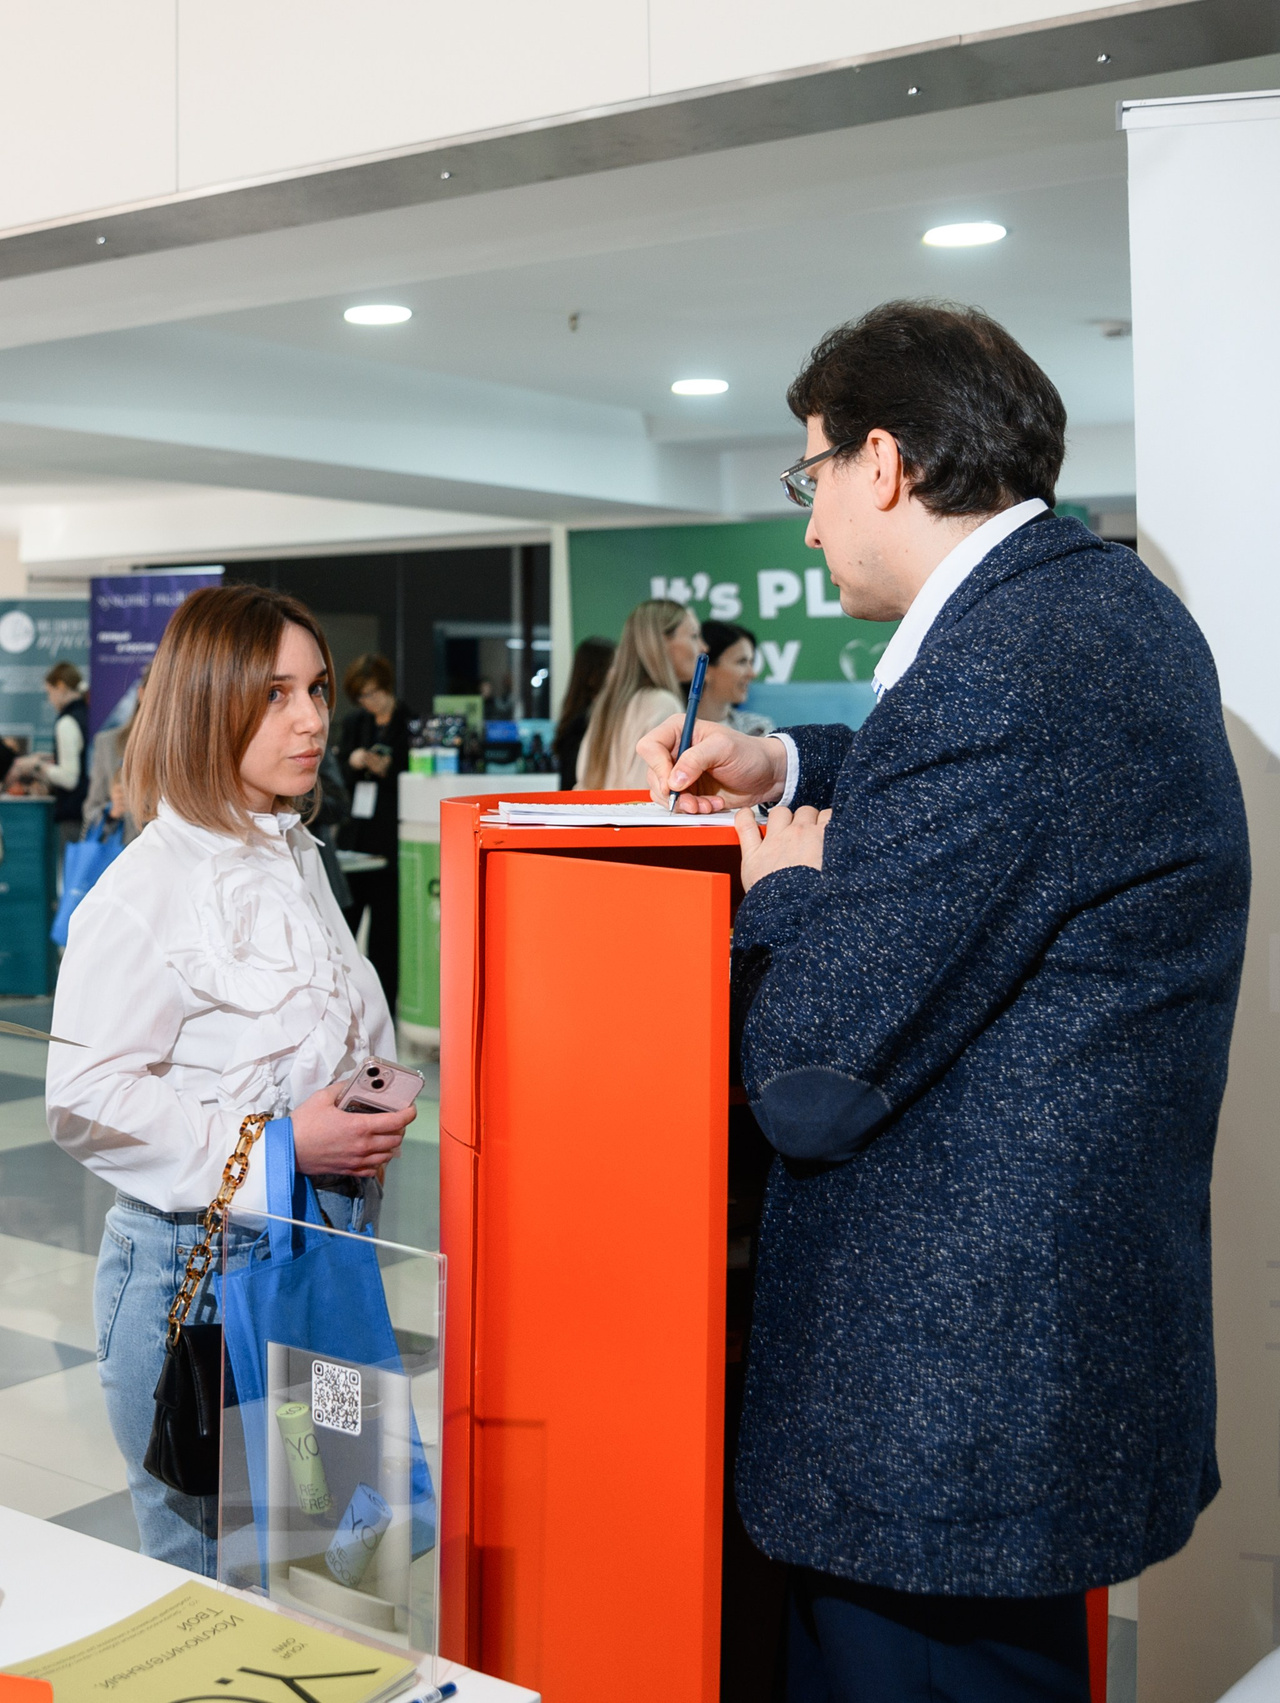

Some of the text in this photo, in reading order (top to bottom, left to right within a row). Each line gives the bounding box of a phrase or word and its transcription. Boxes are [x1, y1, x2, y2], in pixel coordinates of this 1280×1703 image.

[650, 567, 846, 621] It's PL
[176, 1607, 224, 1632] Твой
